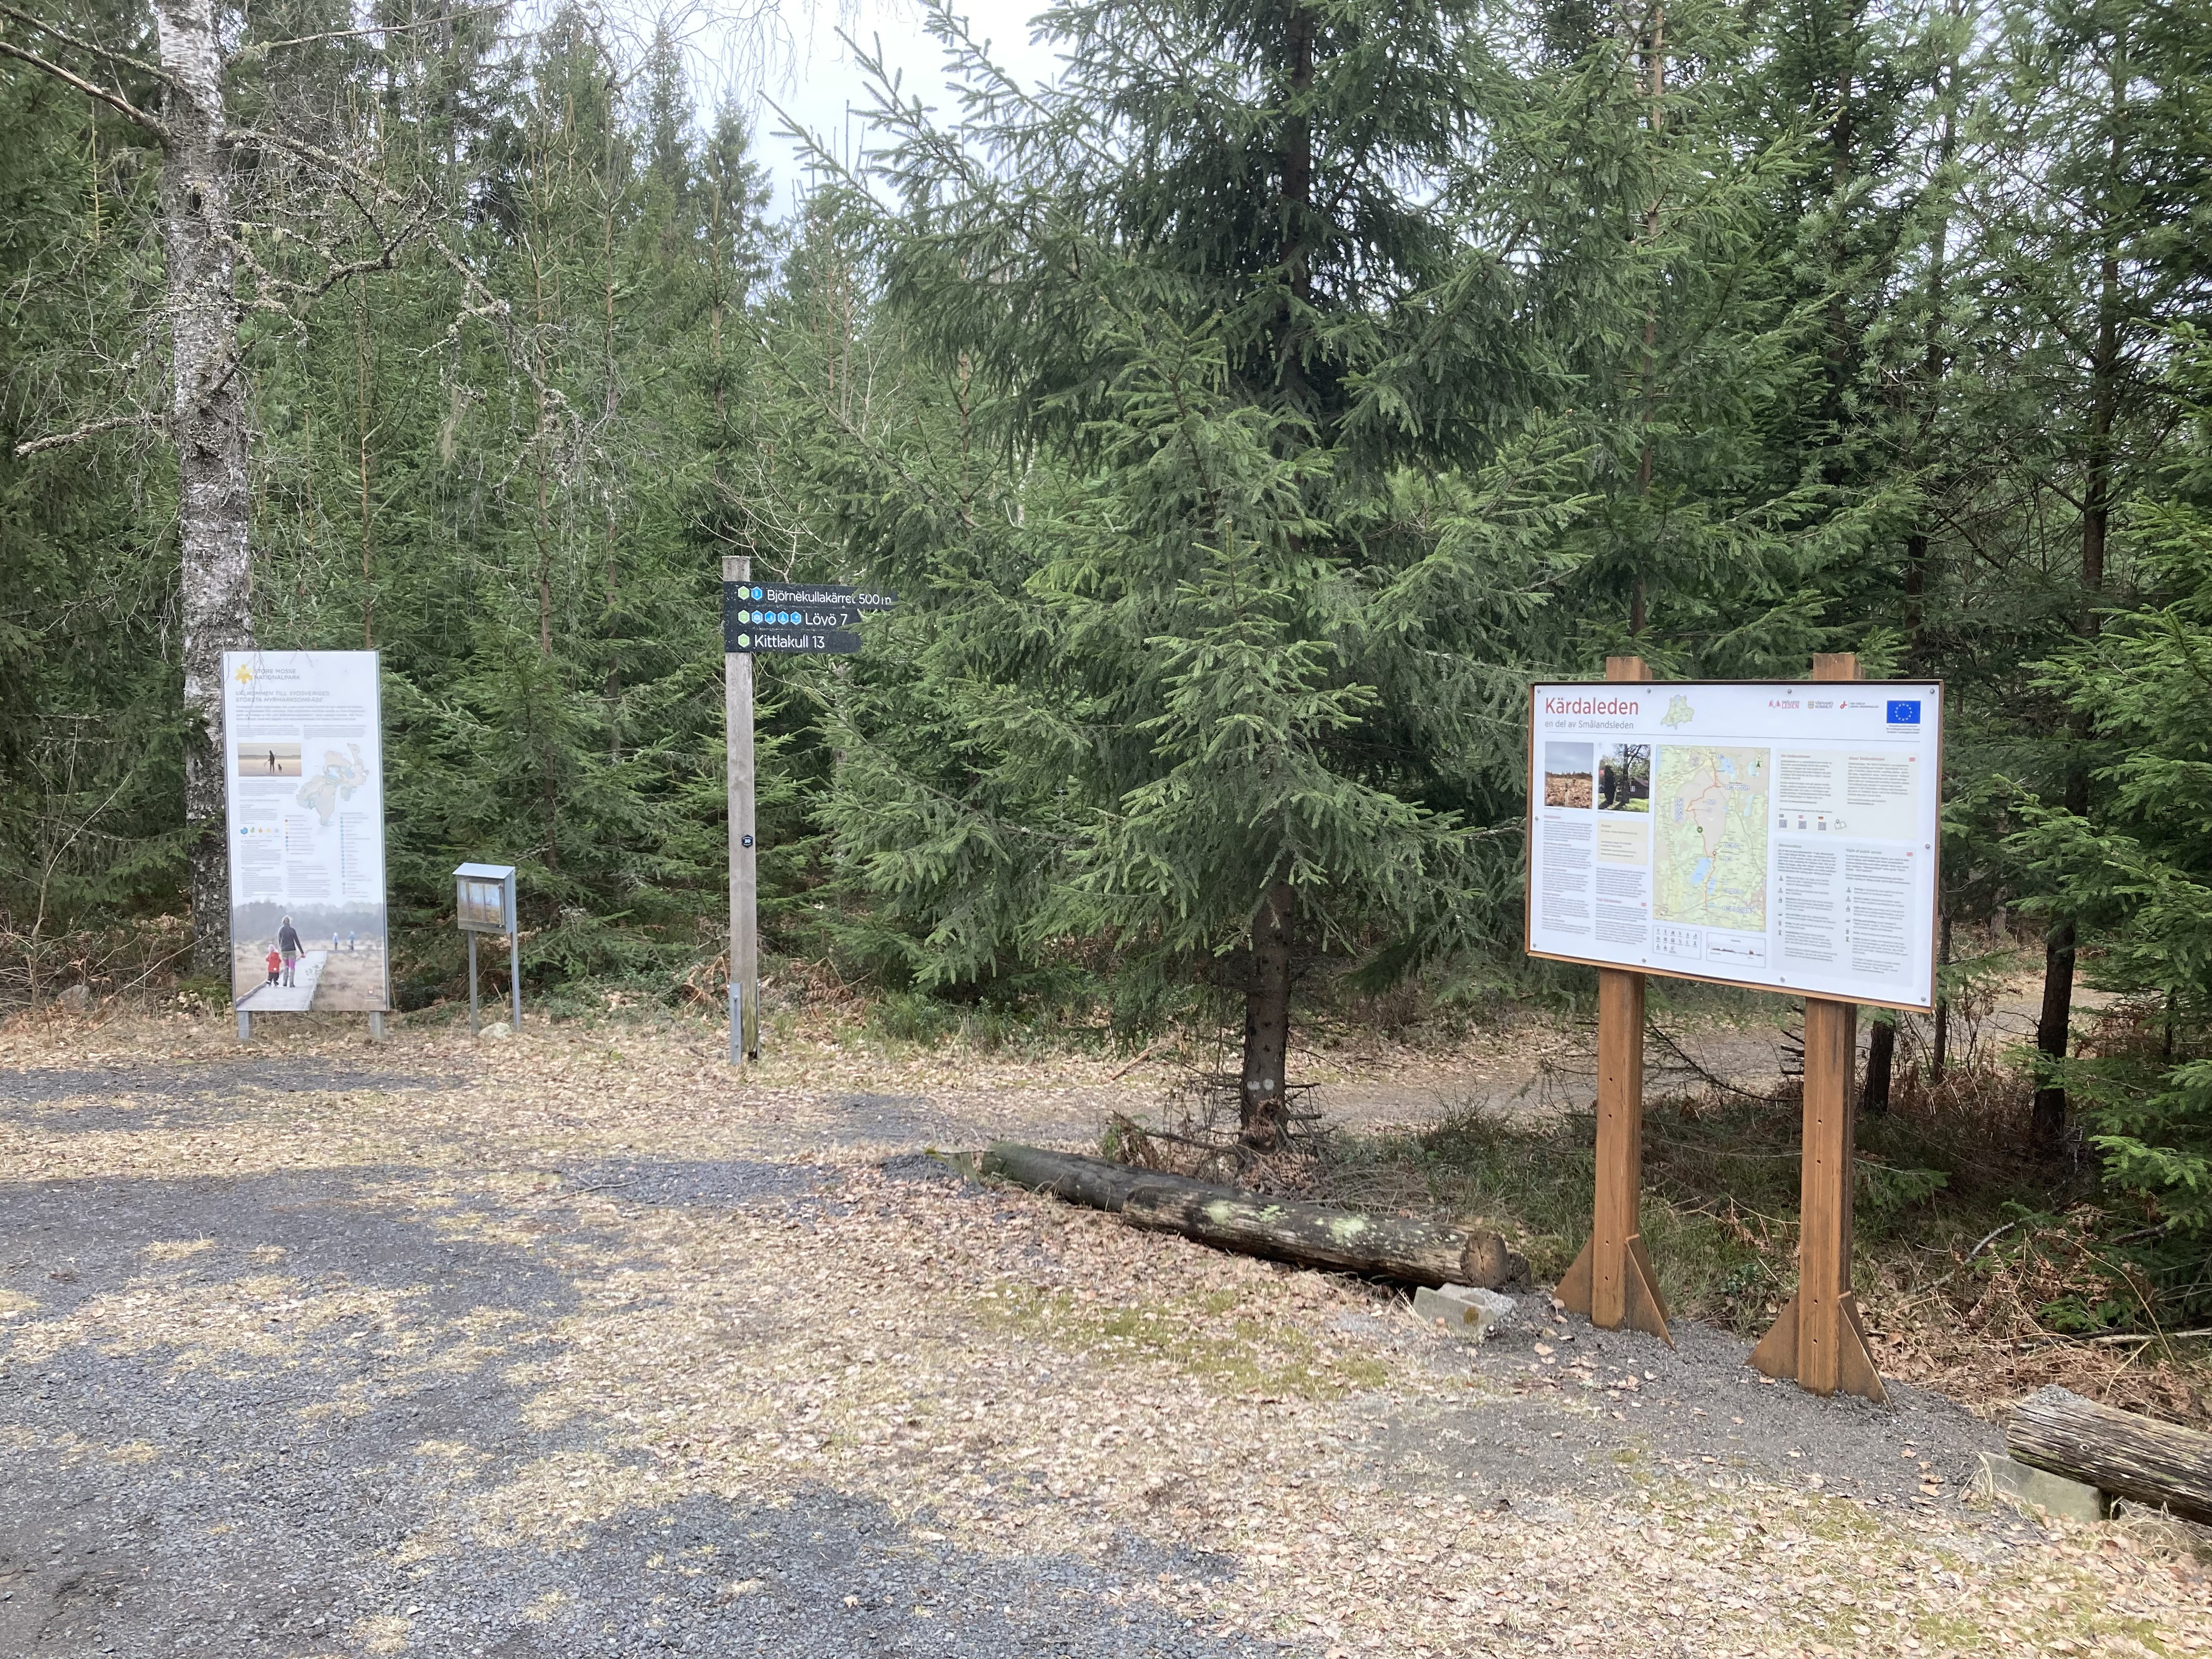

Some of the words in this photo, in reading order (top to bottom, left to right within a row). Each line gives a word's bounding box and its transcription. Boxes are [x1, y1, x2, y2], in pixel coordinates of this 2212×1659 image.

[858, 593, 880, 605] 500
[805, 612, 836, 627] Lövö
[840, 613, 847, 626] 7
[754, 634, 808, 649] Kittlakull
[812, 636, 825, 649] 13
[1546, 697, 1639, 715] Kärdaleden
[1555, 720, 1566, 728] del
[1578, 720, 1634, 729] Smålandsleden
